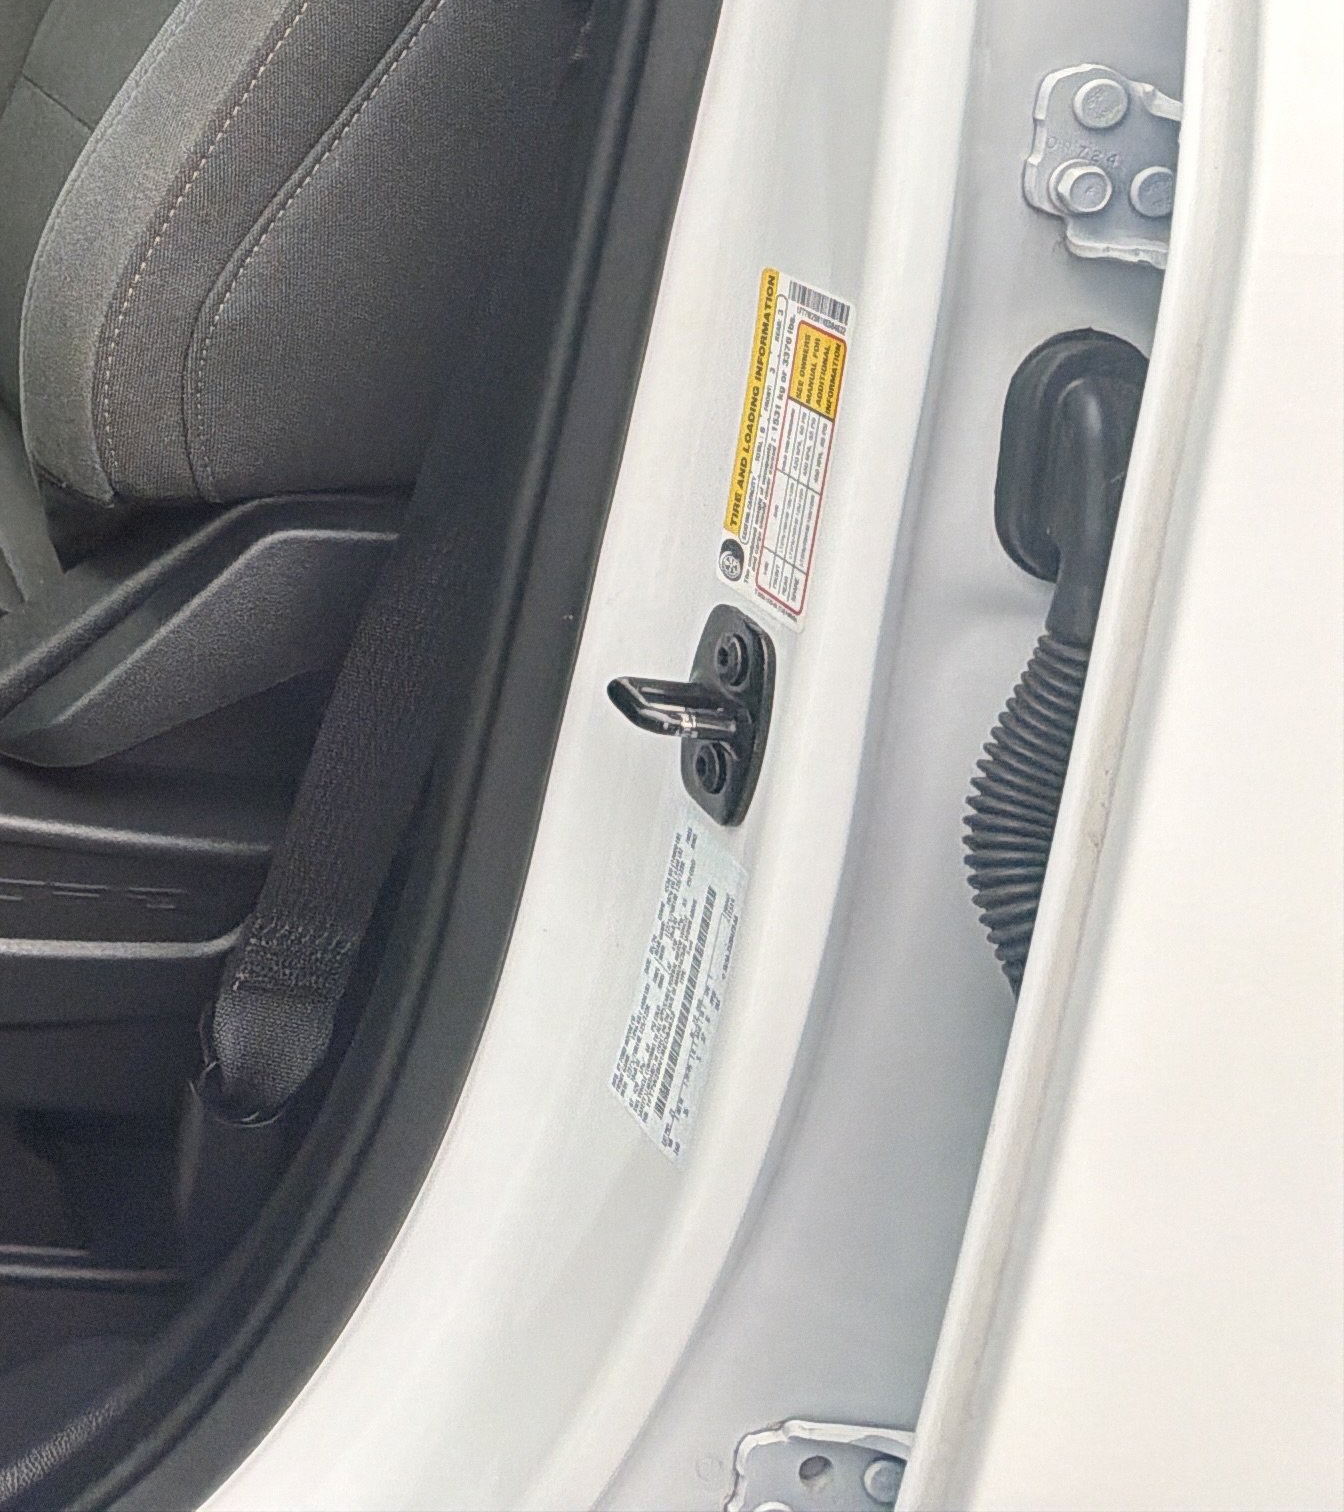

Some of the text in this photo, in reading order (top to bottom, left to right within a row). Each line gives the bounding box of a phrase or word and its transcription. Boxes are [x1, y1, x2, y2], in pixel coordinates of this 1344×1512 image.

[754, 274, 776, 382] INFORMATION
[824, 342, 842, 416] INFORMATION
[742, 386, 760, 454] LOADING
[737, 456, 748, 489] AND
[730, 491, 743, 527] TIRE
